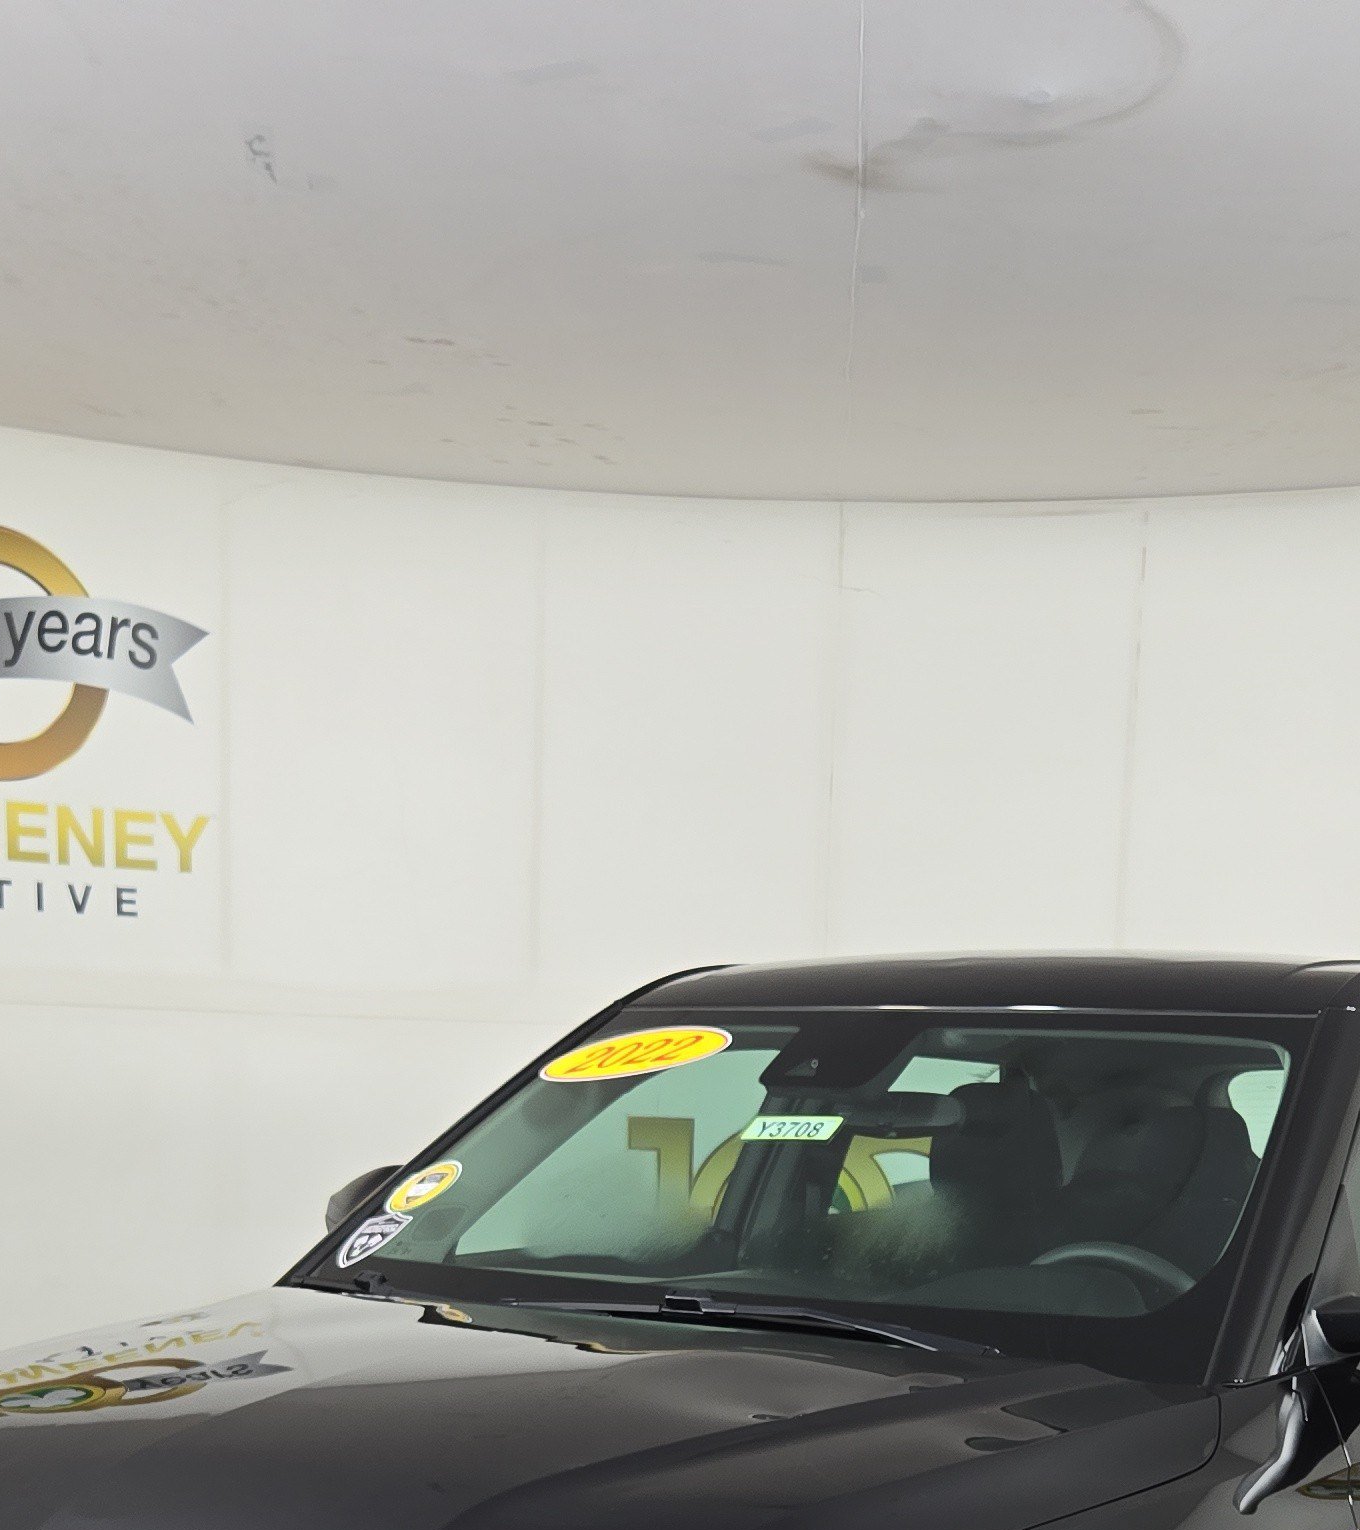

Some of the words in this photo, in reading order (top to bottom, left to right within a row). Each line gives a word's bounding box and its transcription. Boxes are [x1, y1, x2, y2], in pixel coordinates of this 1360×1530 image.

[2, 607, 160, 670] years
[564, 1034, 704, 1074] 2022
[757, 1121, 825, 1139] Y3708
